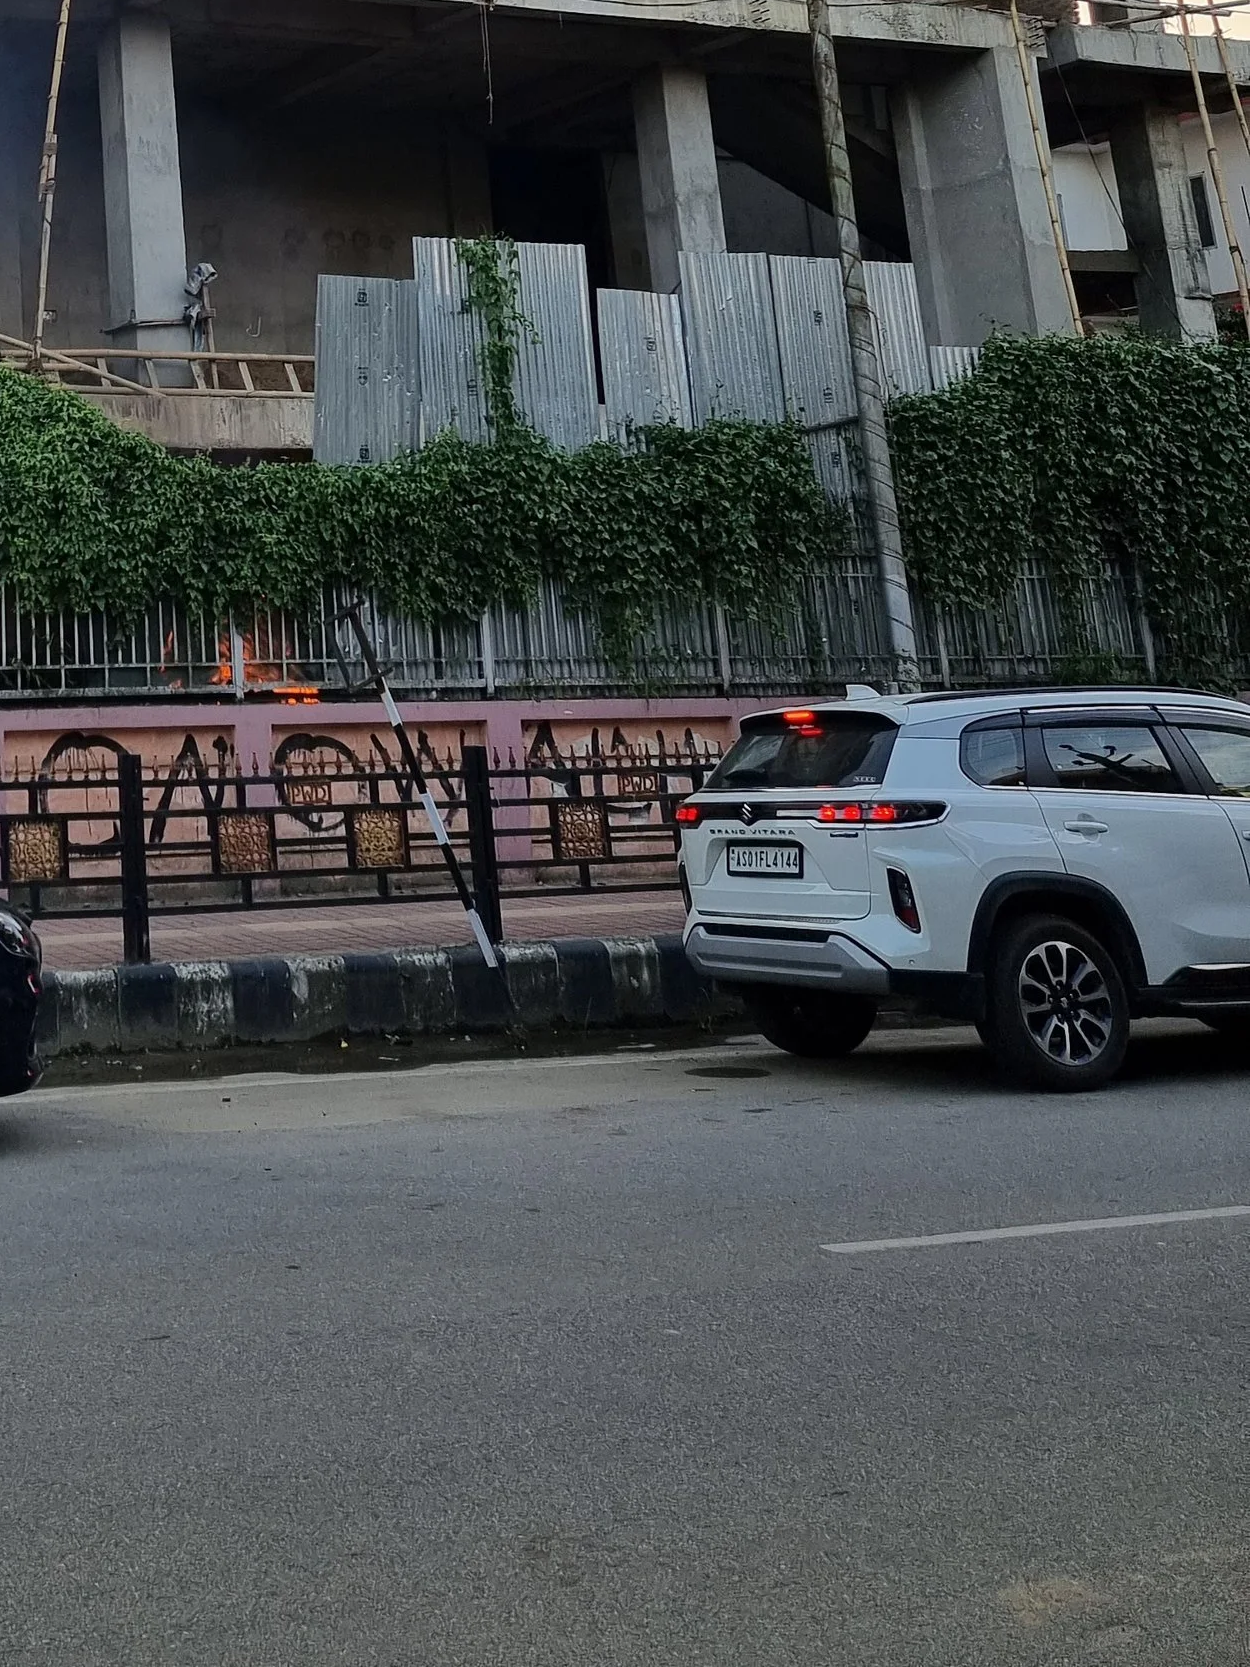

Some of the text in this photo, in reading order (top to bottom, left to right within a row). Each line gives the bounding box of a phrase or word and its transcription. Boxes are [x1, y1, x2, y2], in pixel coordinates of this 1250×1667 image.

[291, 784, 327, 804] PWD
[623, 777, 655, 793] PWD
[736, 850, 798, 868] AS01FL4144
